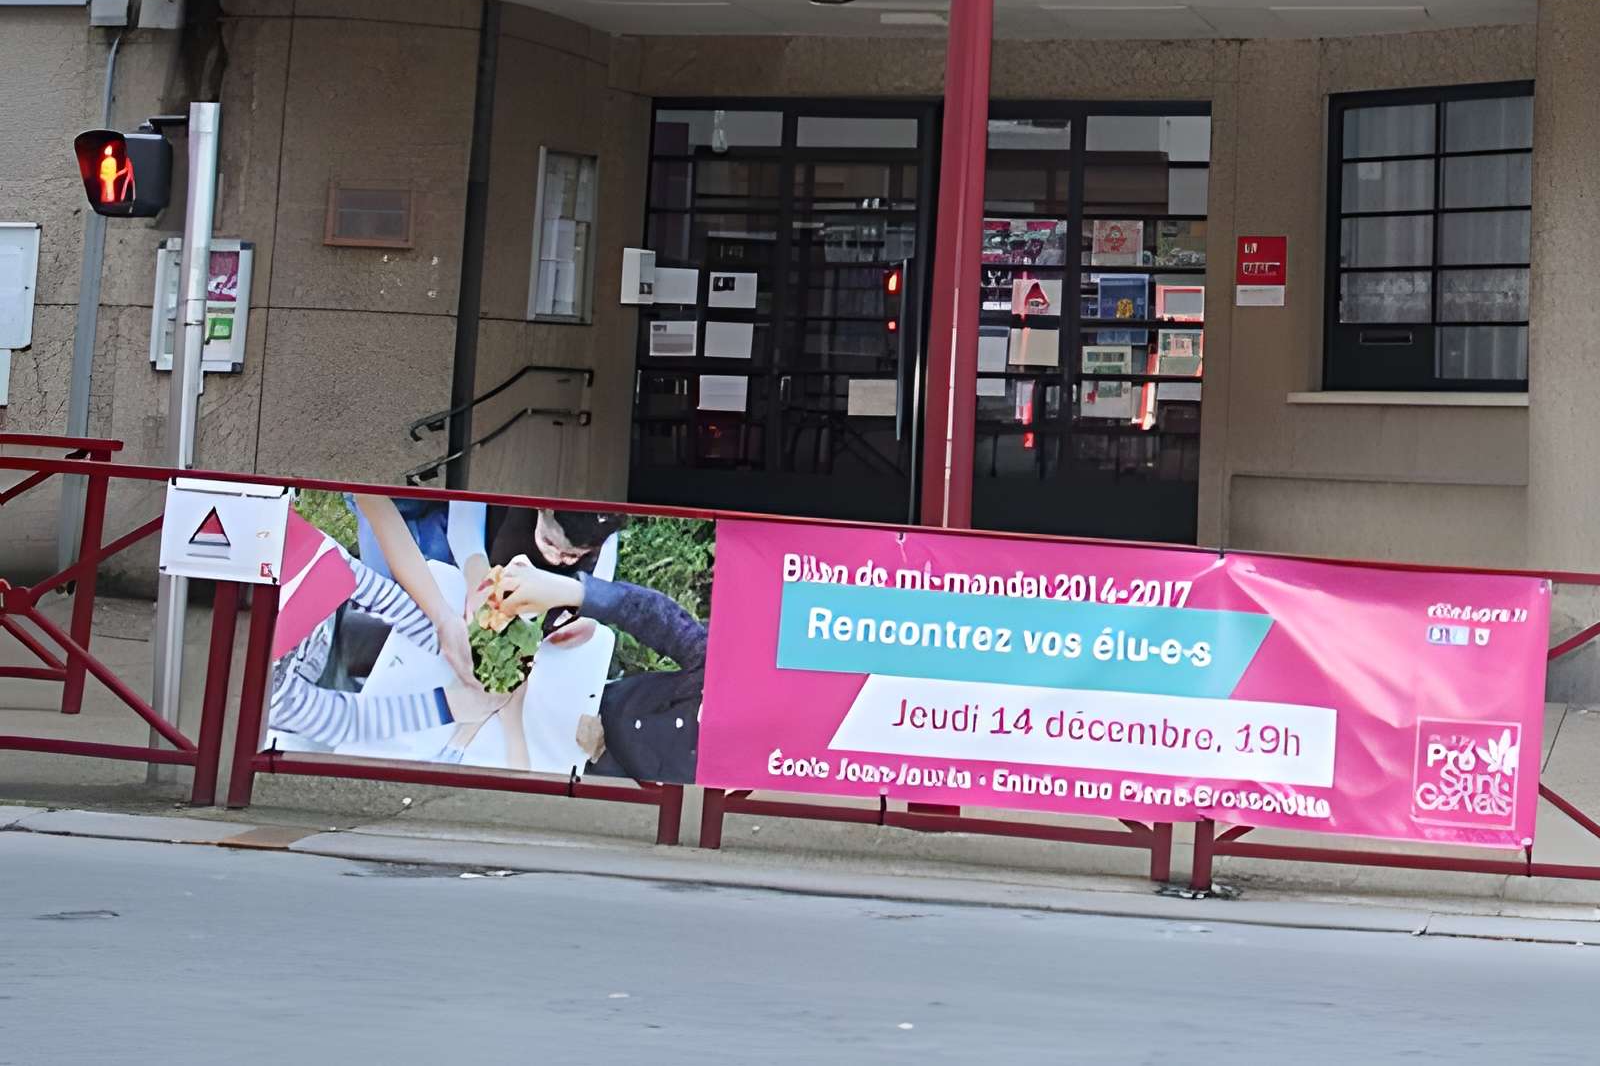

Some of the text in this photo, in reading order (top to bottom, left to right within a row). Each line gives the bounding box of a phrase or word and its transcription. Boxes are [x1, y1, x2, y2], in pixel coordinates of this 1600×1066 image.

[1053, 573, 1193, 608] 2014-2017
[807, 606, 1012, 653] Rencontrez
[1023, 629, 1083, 659] vos
[892, 698, 979, 734] Jeudi
[989, 706, 1034, 735] 14
[1235, 722, 1301, 758] 19h
